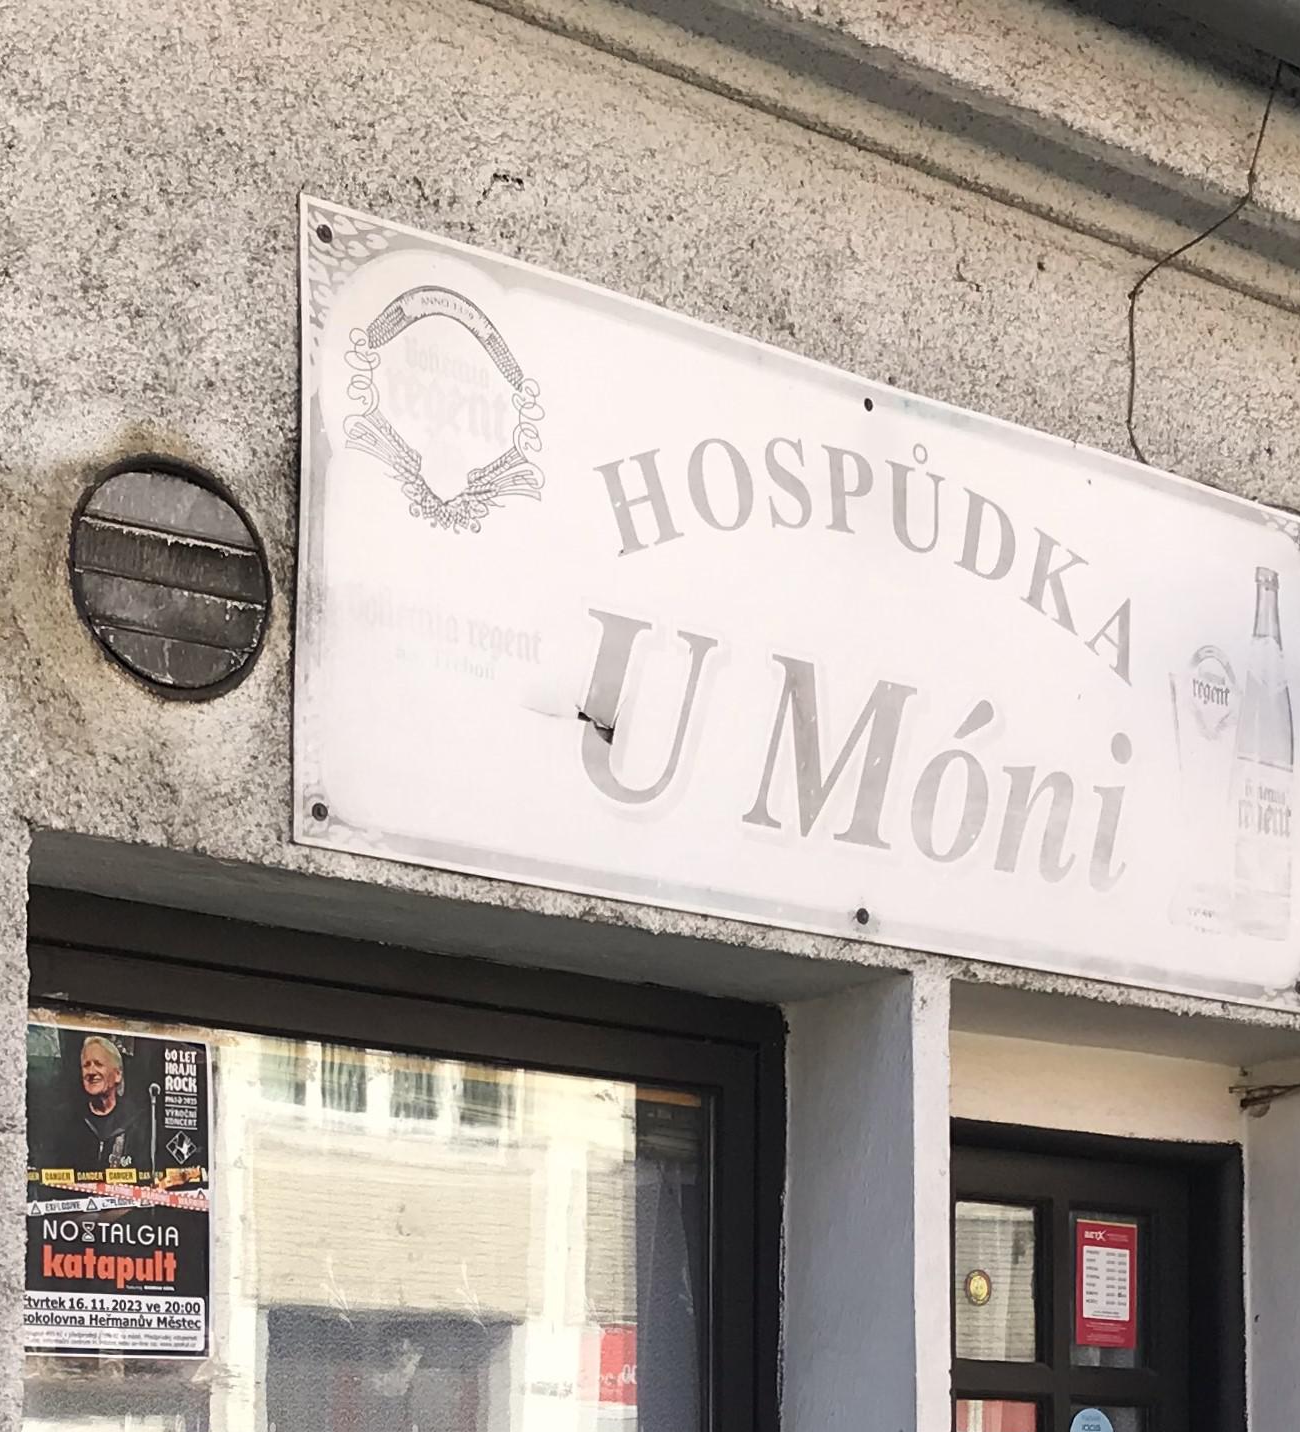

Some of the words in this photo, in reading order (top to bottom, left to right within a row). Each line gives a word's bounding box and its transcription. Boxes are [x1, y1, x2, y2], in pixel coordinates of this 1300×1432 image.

[592, 436, 1133, 687] HOSPŮDKA
[580, 607, 719, 806] U
[741, 652, 1133, 893] Móni
[164, 1048, 178, 1062] 60
[179, 1050, 197, 1064] LET
[164, 1061, 197, 1077] HRAJU
[164, 1075, 198, 1093] ROCK
[44, 1171, 72, 1181] DANGER
[77, 1171, 104, 1181] DANGER
[108, 1171, 134, 1180] DANGER
[45, 1201, 82, 1212] EXPLOSIVE
[42, 1244, 177, 1289] katapult
[111, 1299, 143, 1312] 2023
[145, 1302, 161, 1312] ve
[164, 1301, 201, 1314] 20:00
[89, 1314, 153, 1328] Heřmanův
[157, 1317, 202, 1329] Městec
